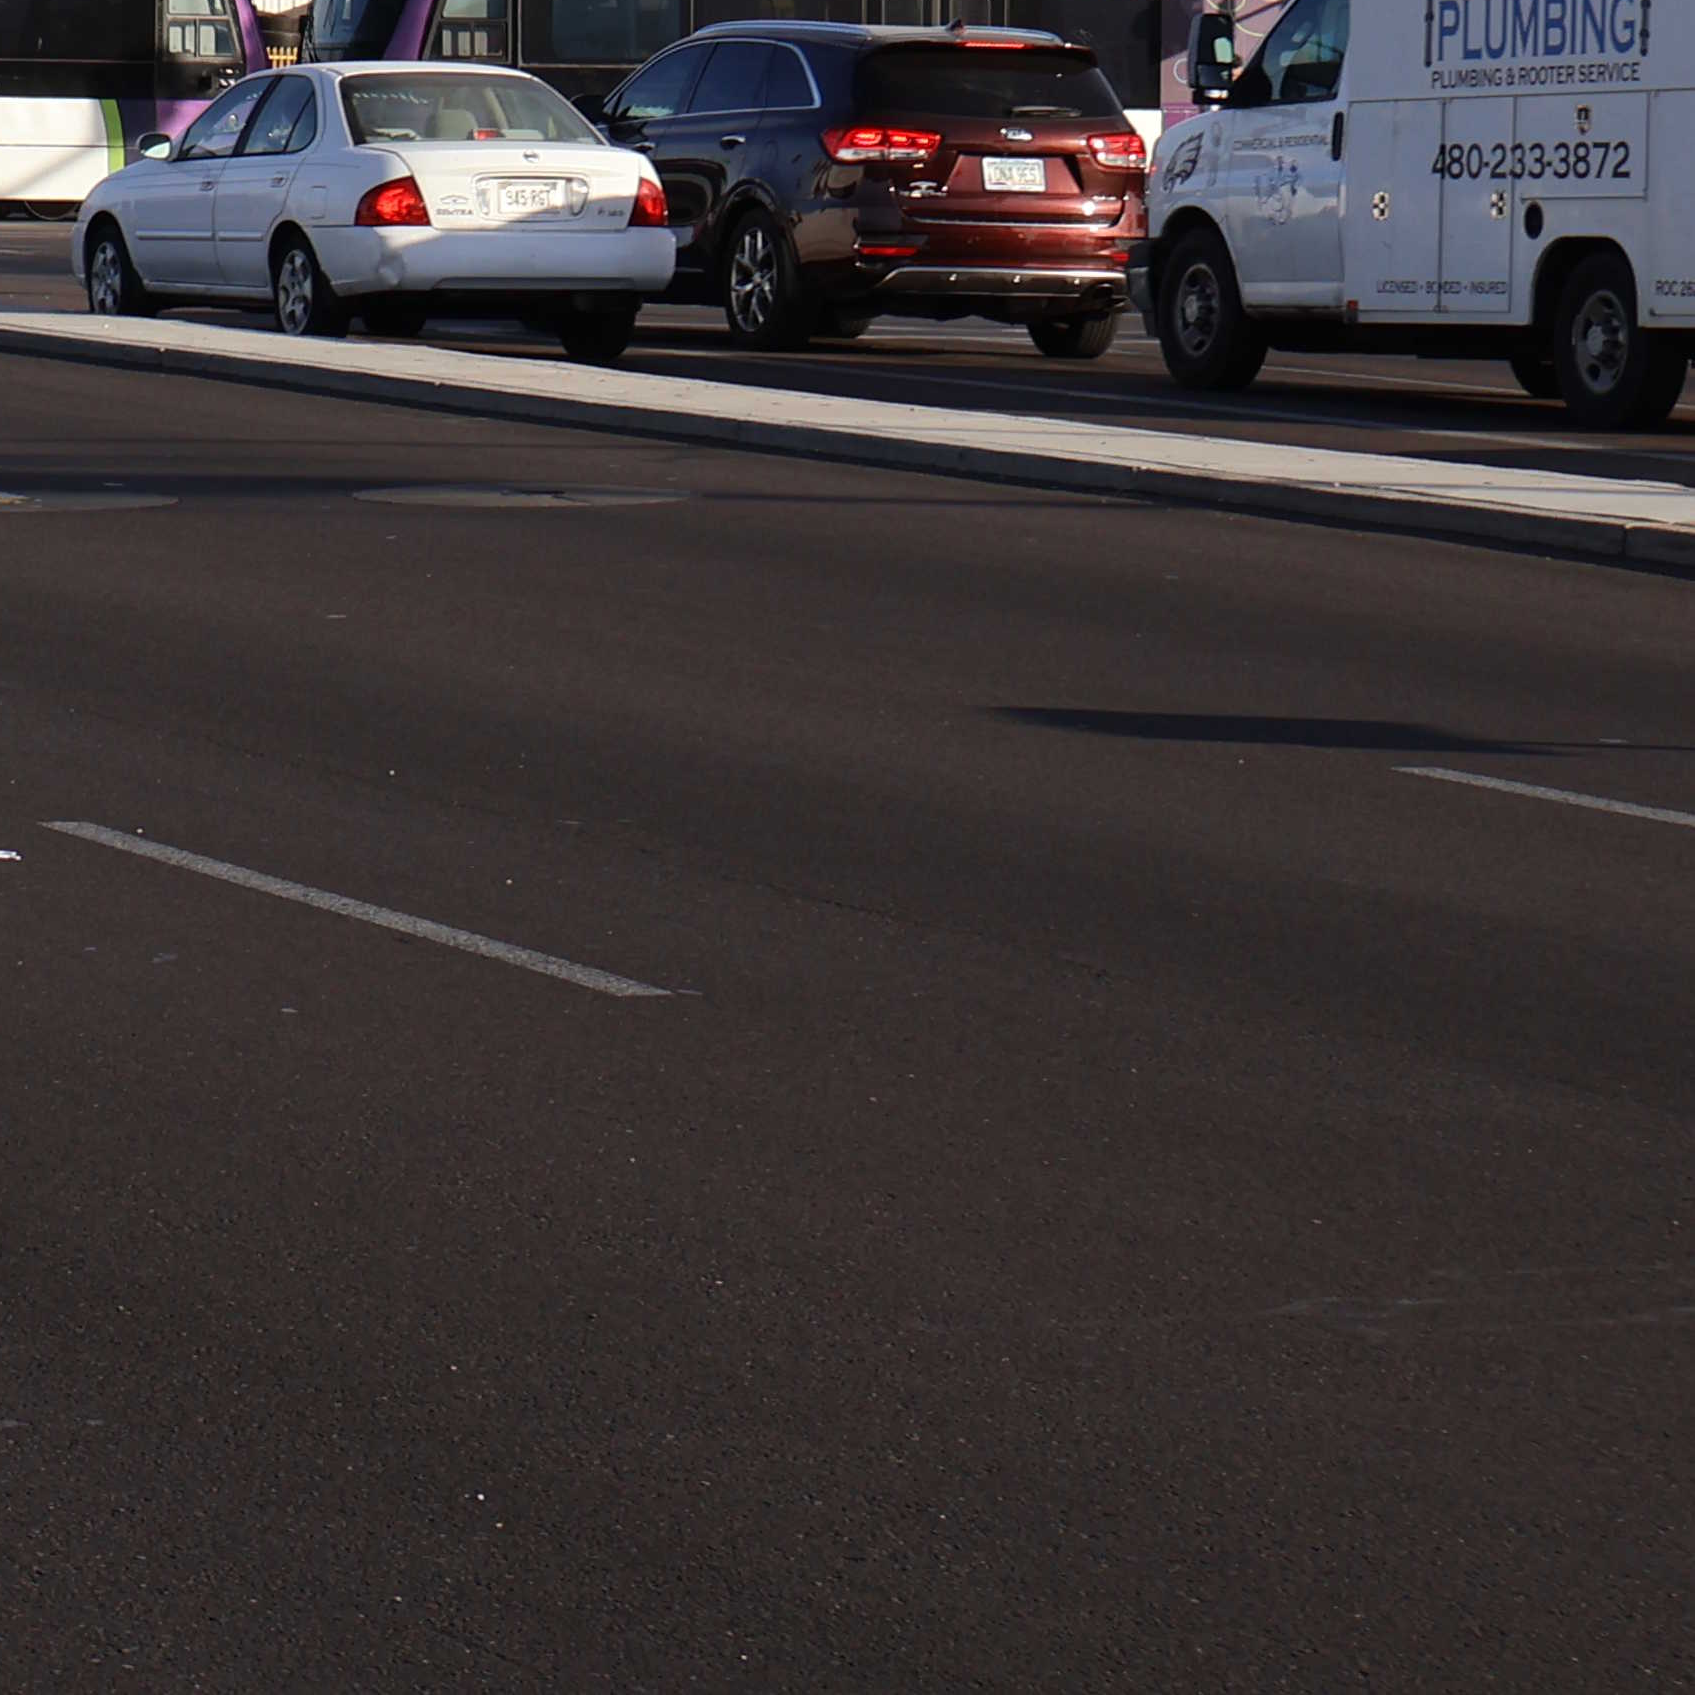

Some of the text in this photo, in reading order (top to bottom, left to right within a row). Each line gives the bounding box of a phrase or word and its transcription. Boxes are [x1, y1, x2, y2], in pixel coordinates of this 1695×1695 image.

[1431, 61, 1641, 89] PLUMBING & ROOTER SERVICE
[1431, 141, 1631, 180] 480-233-3872
